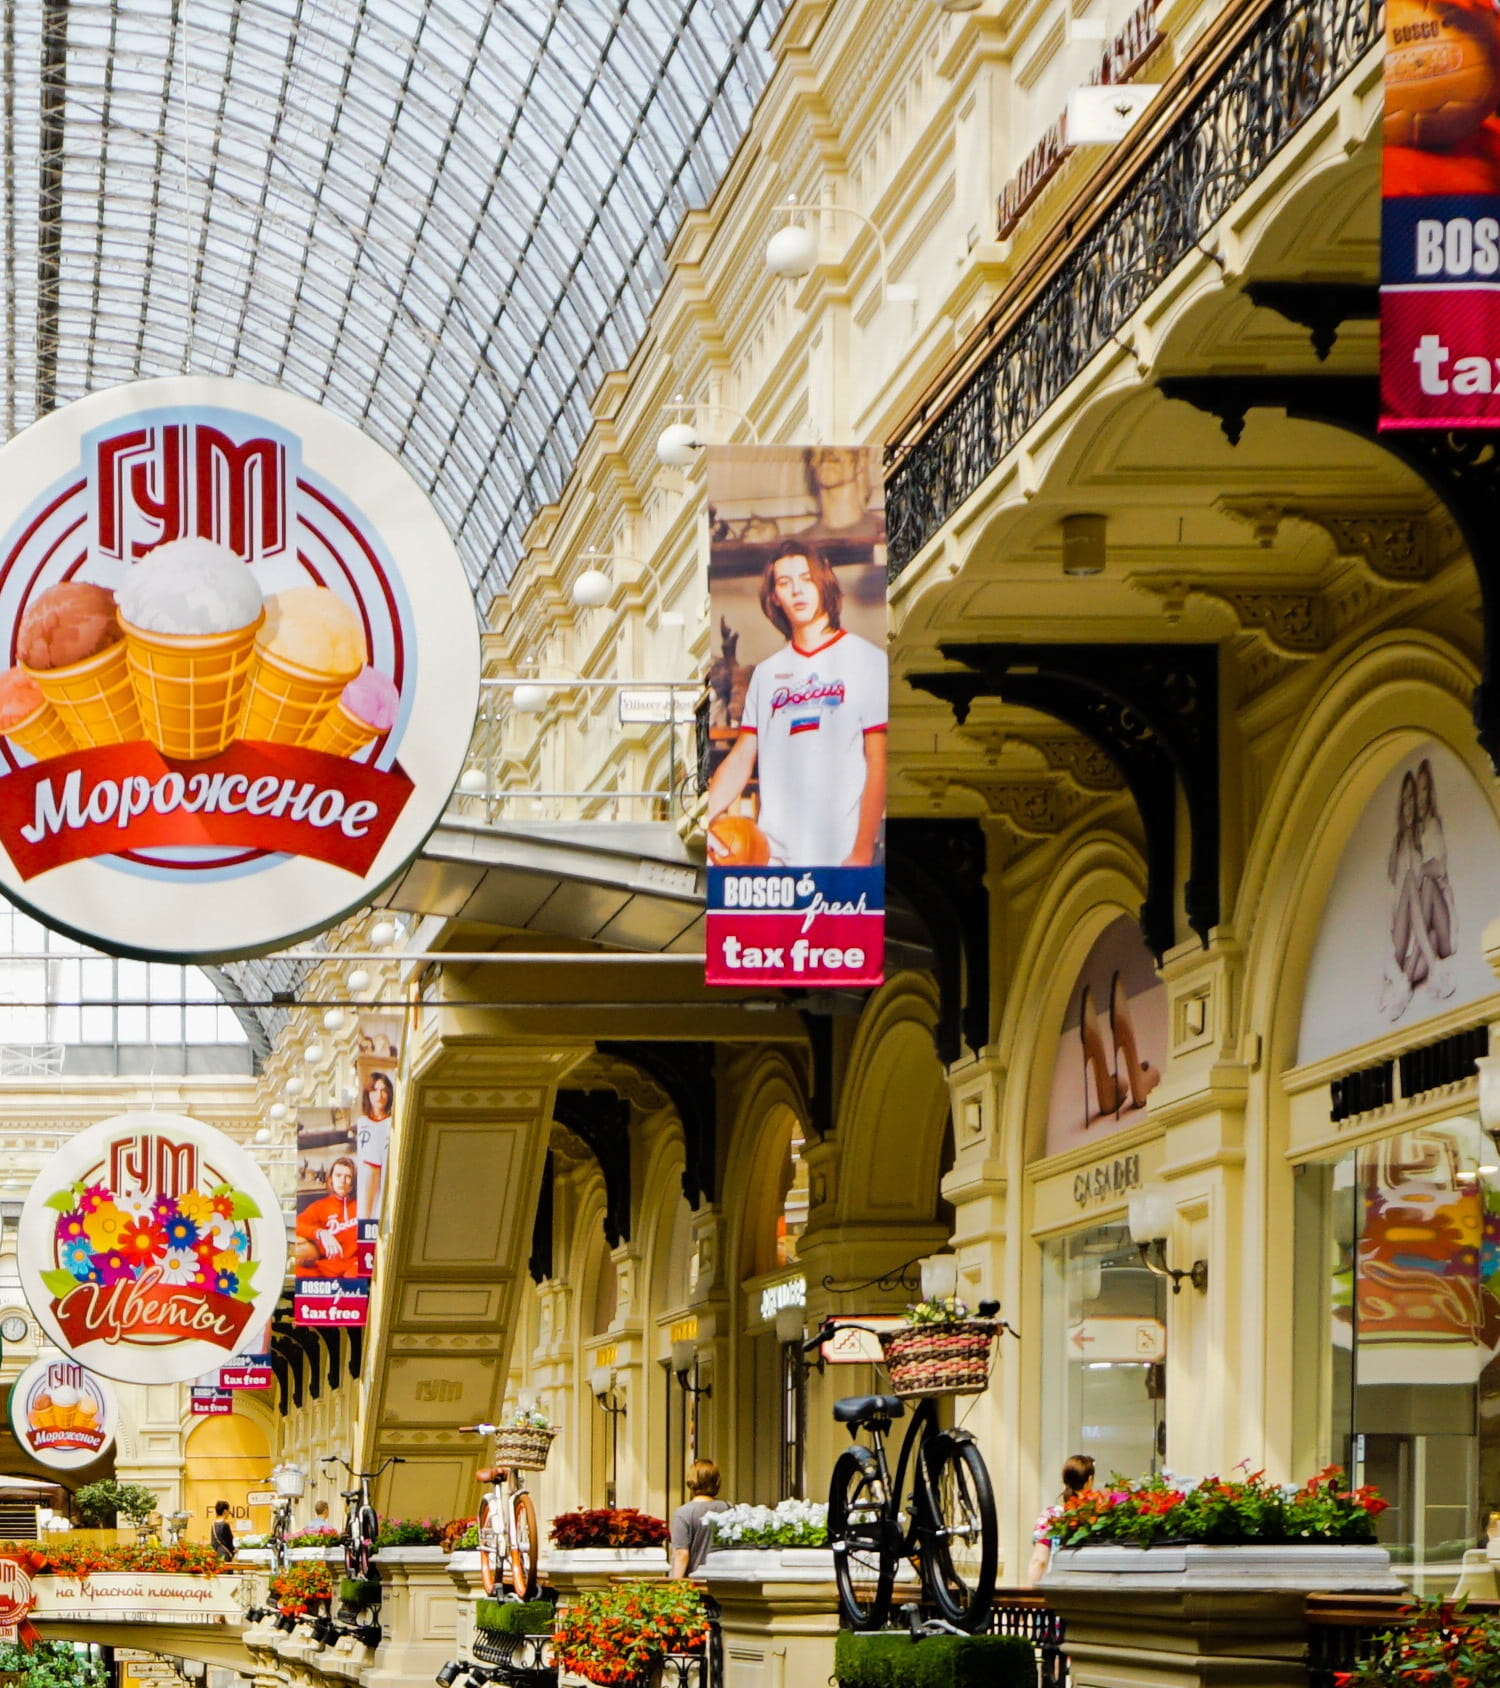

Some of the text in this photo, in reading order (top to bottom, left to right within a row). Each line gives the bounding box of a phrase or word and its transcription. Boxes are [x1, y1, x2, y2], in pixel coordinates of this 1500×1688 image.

[1393, 20, 1440, 45] BOSCO
[97, 423, 287, 563] ГУМ
[21, 769, 377, 844] Мороженое
[723, 876, 868, 933] BOSCO fresh
[723, 936, 865, 972] tax free
[110, 1135, 198, 1197] ГУМ
[1073, 1153, 1139, 1203] CASADEI
[301, 1282, 331, 1294] BOSCO
[57, 1265, 235, 1344] Цветы
[301, 1305, 360, 1320] tax free
[48, 1363, 84, 1389] ГУМ
[34, 1432, 101, 1446] Мороженое
[206, 1506, 250, 1519] FNDI
[56, 1580, 213, 1601] на Красной площади
